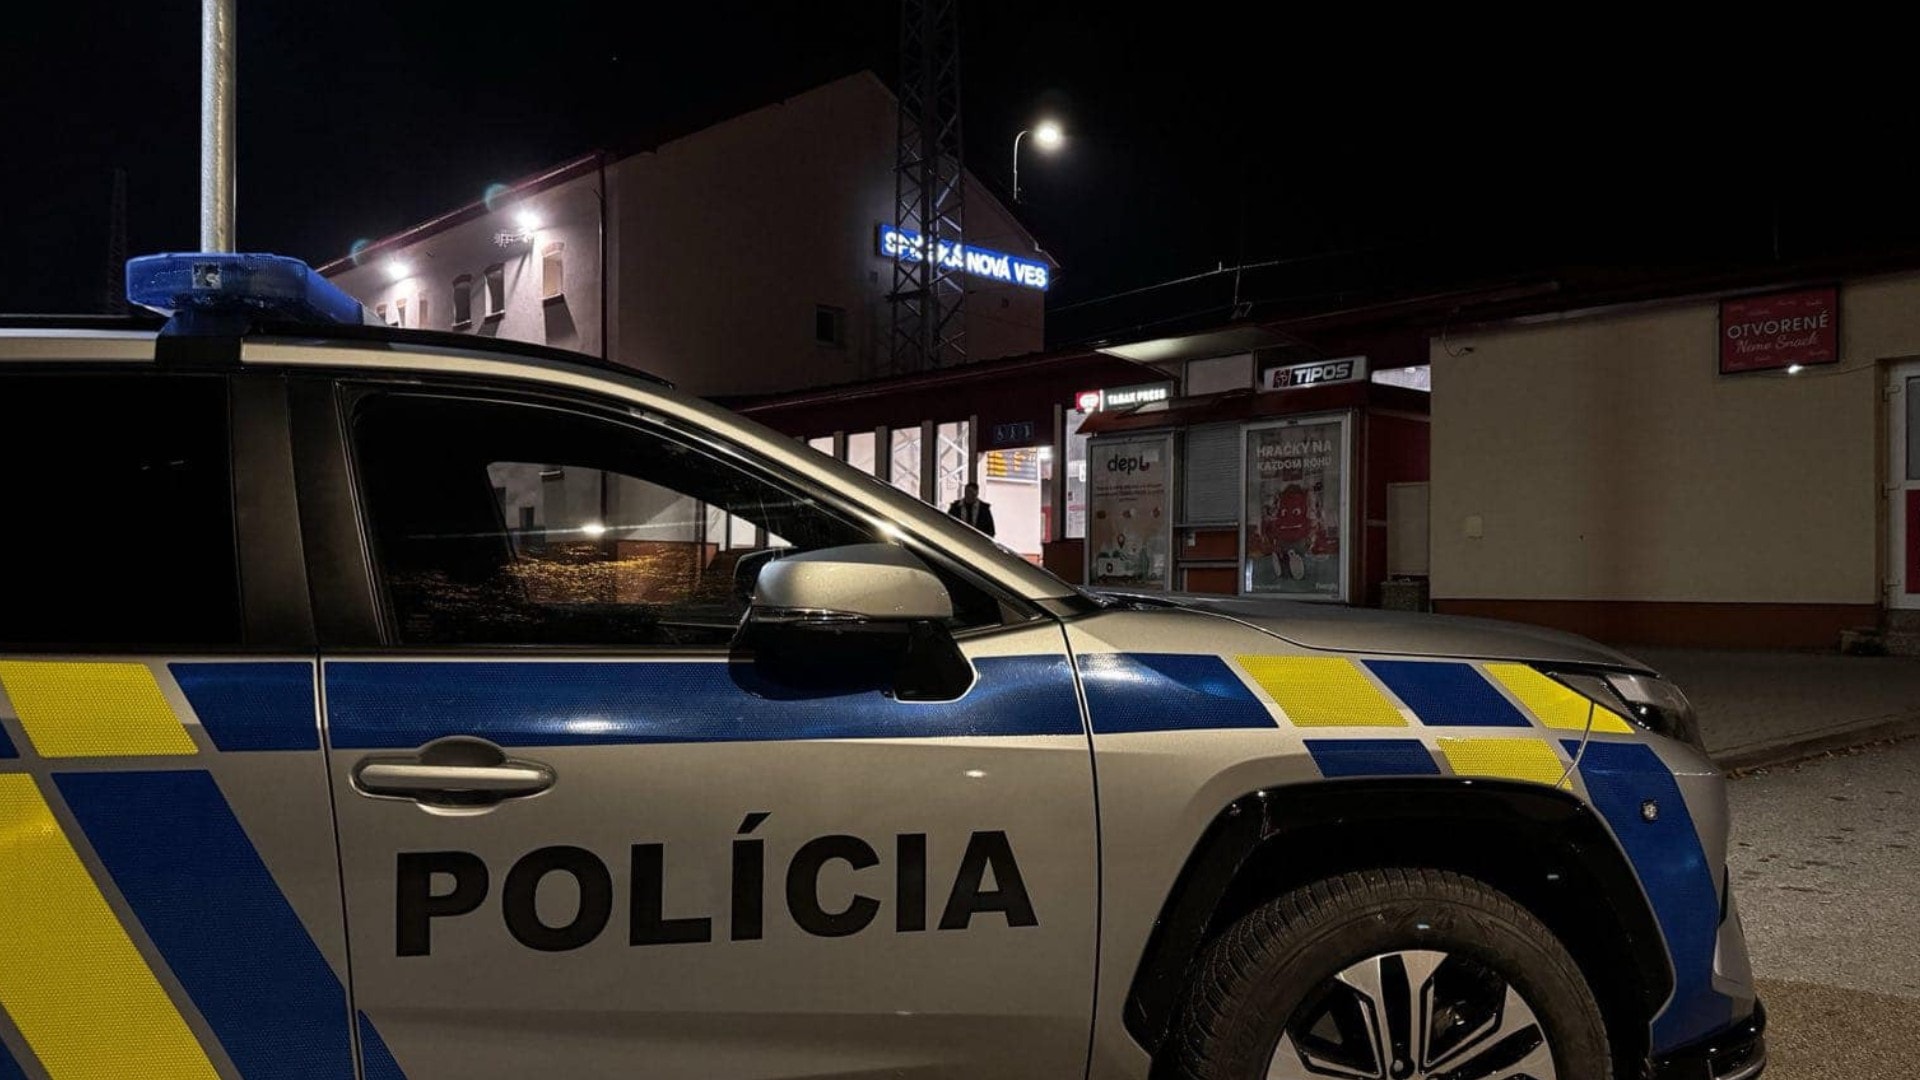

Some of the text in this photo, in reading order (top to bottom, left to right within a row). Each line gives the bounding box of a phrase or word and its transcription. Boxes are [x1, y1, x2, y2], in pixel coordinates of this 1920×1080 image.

[967, 251, 1011, 280] NOVÁ
[1015, 265, 1046, 287] VES
[1727, 310, 1829, 339] OTVORENÉ
[1294, 363, 1350, 383] TIPOS
[1137, 388, 1166, 402] PRESS
[1312, 440, 1332, 454] NA
[396, 812, 1039, 957] POLÍCIA
